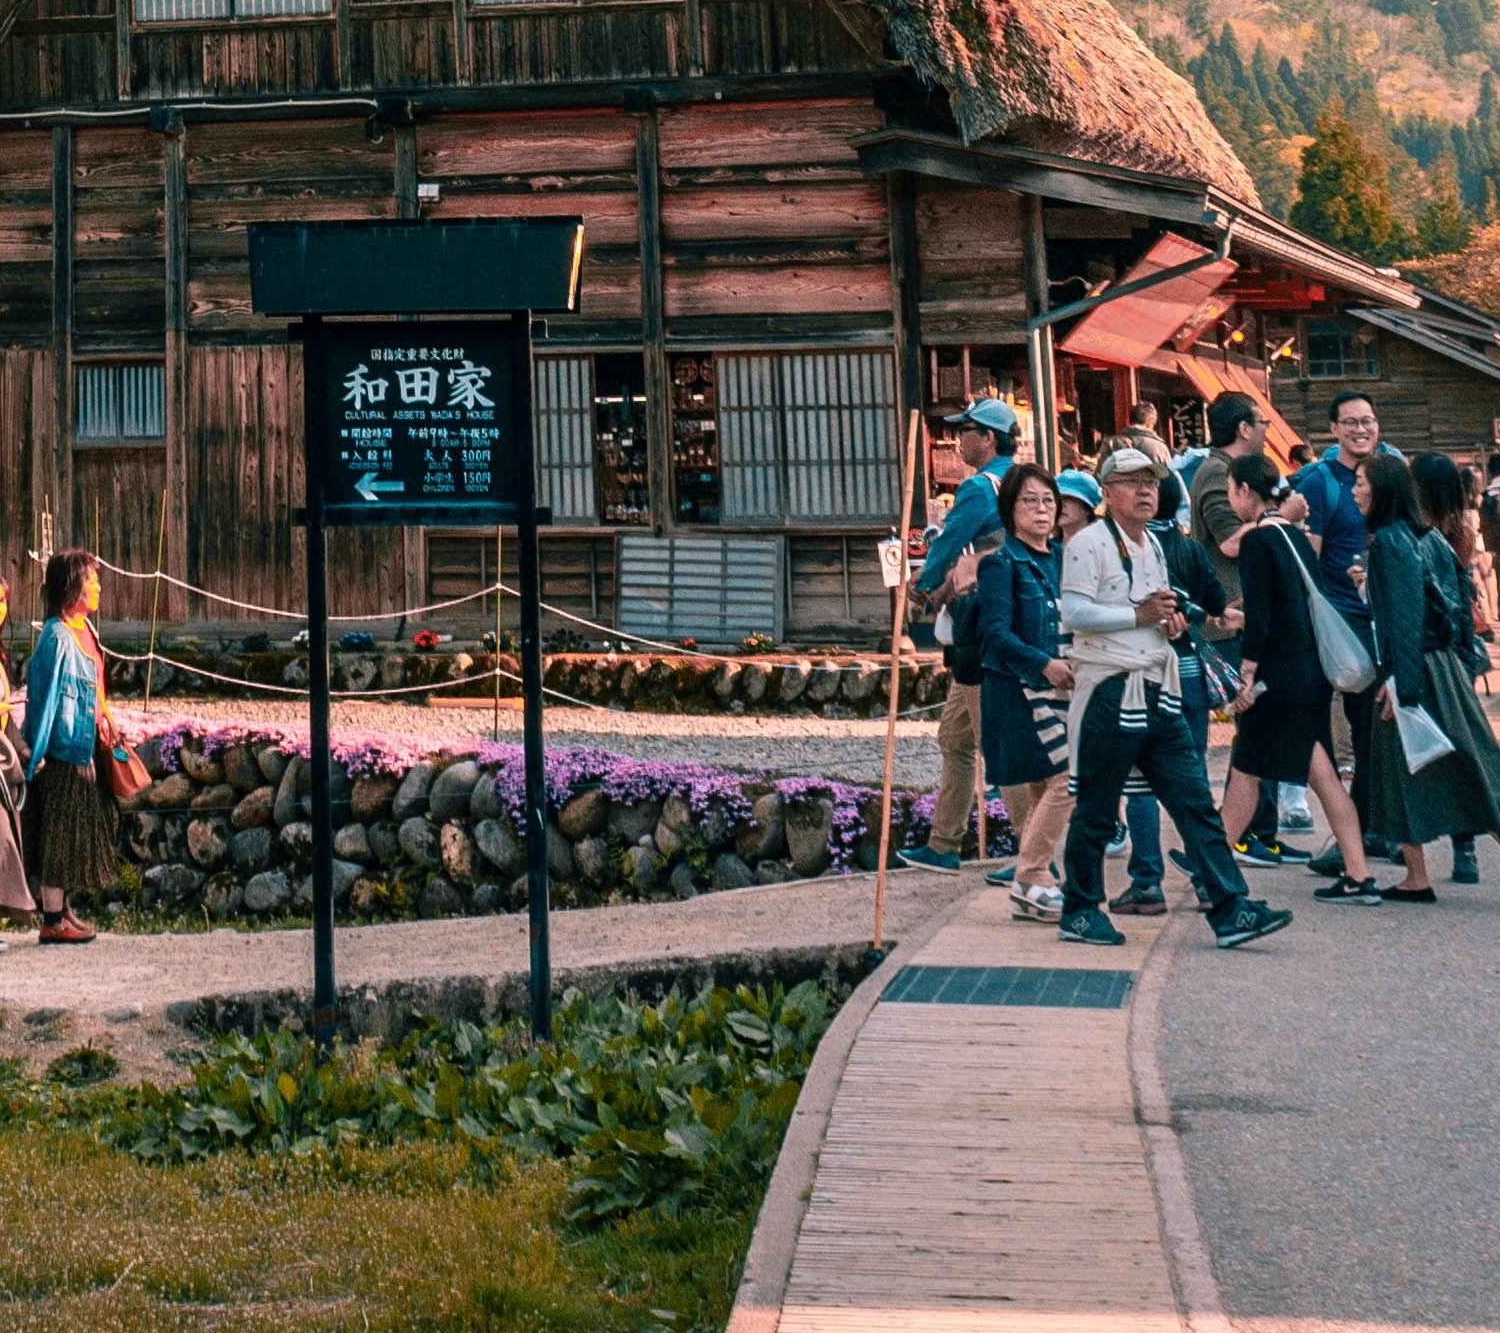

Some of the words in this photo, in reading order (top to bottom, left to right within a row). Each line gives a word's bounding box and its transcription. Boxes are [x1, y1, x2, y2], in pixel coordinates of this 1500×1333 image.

[370, 347, 465, 361] 国指定重要文化財
[342, 360, 495, 410] 和田家
[344, 410, 387, 420] CULTURAL
[393, 410, 426, 420] ASSETS
[430, 410, 461, 420] WADA'S
[466, 410, 495, 420] HOUSE
[461, 449, 491, 461] 300円
[463, 471, 491, 484] 150円
[422, 484, 455, 493] CHILDREN
